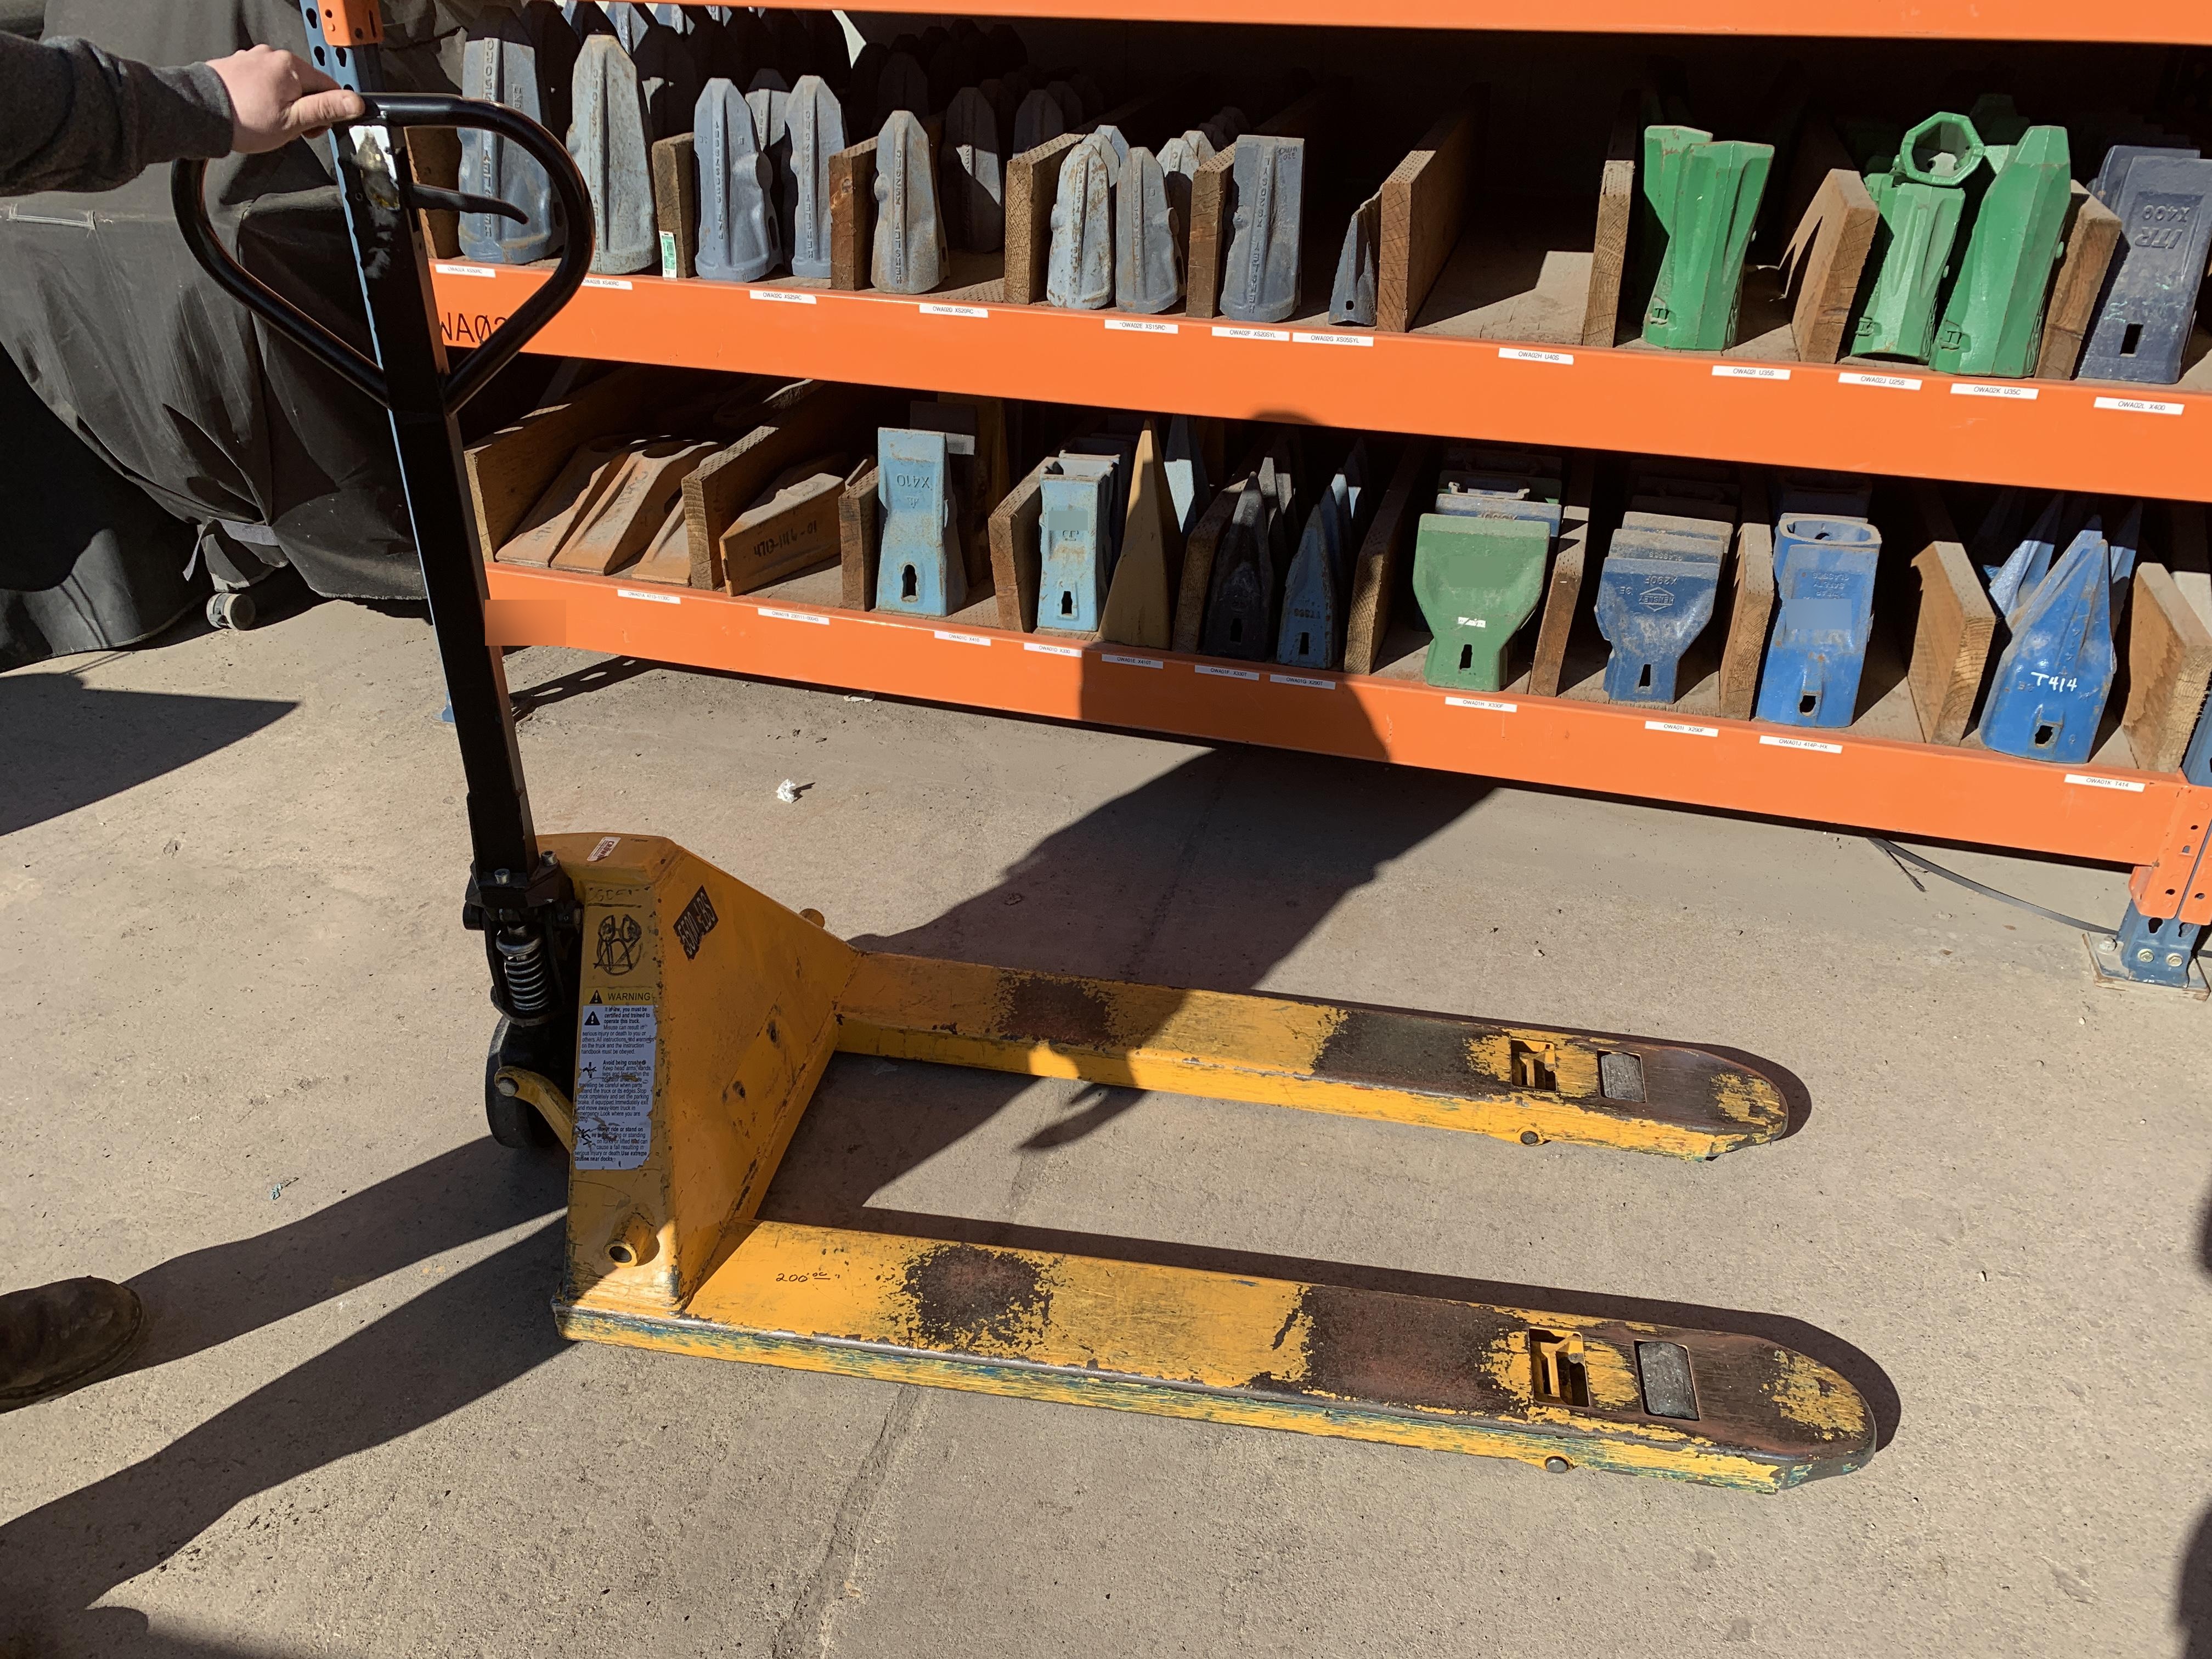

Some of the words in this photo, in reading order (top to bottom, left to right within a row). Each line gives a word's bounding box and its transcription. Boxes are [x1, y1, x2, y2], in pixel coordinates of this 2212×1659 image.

[2142, 205, 2191, 223] X400
[2134, 227, 2183, 250] ITR
[1518, 351, 1542, 359] OWA02H
[1860, 376, 1887, 384] OWA02J
[1973, 386, 2001, 394] OWA02K
[2118, 401, 2146, 409] OWA02L
[896, 475, 930, 489] X410
[1638, 595, 1675, 605] HENSLEY
[2031, 671, 2078, 692] T414
[2086, 777, 2112, 786] OWA01K
[693, 891, 716, 932] LBS
[608, 992, 651, 1001] WARNING
[776, 1273, 808, 1282] 200
